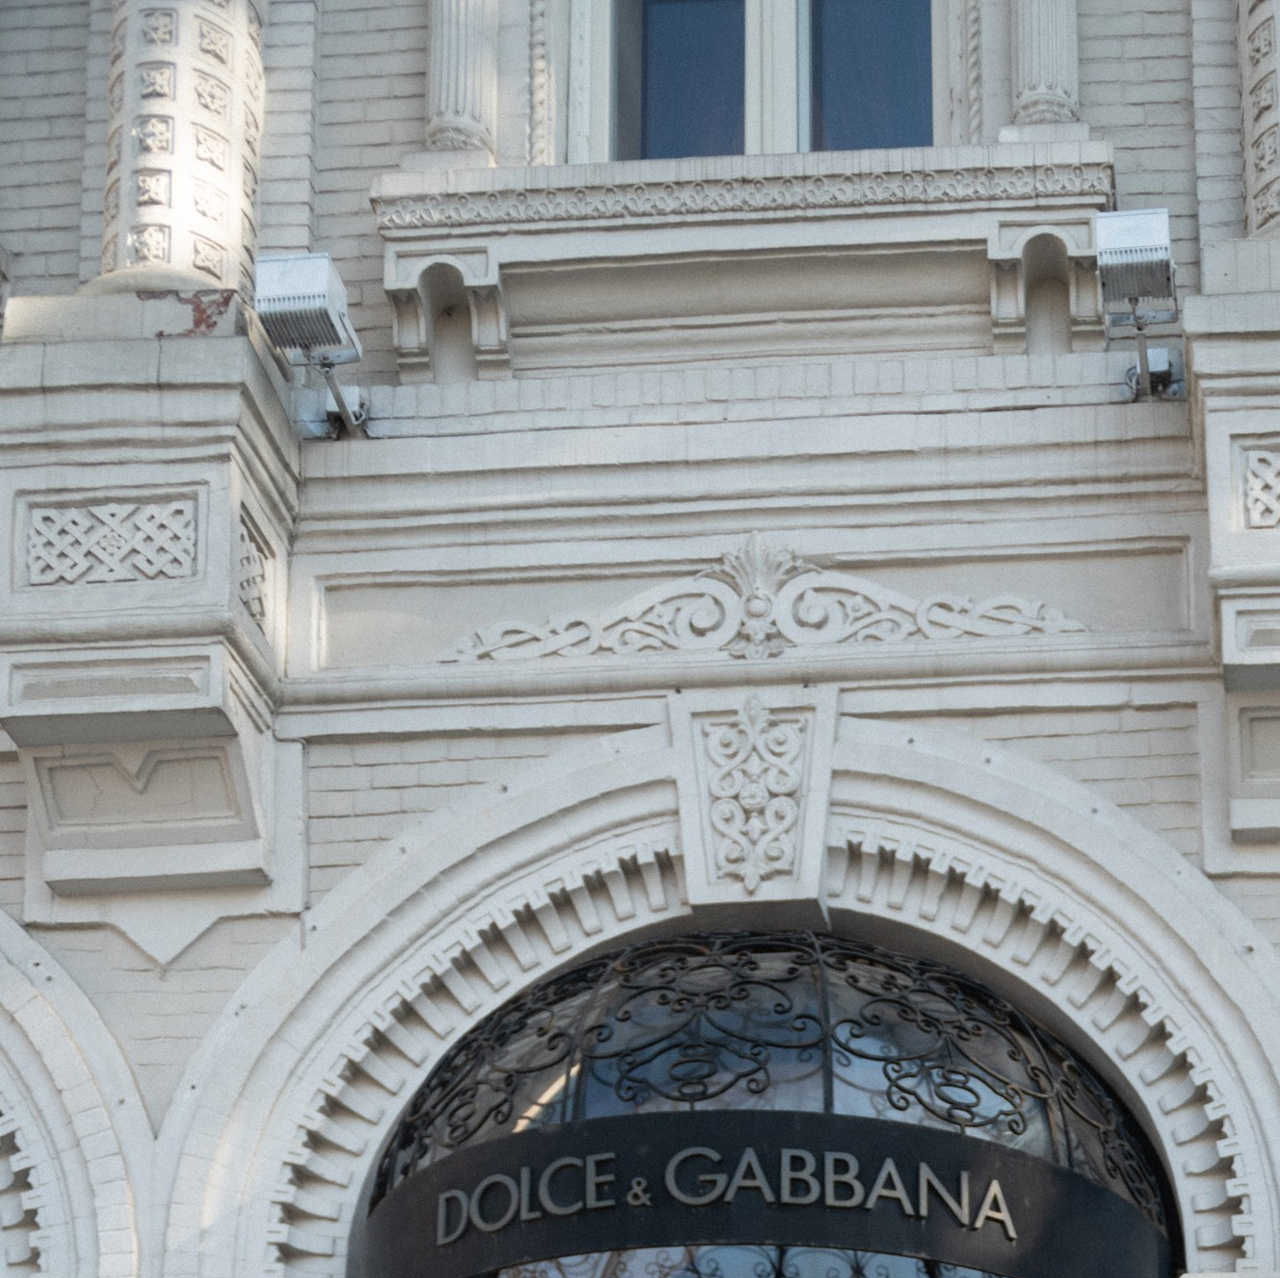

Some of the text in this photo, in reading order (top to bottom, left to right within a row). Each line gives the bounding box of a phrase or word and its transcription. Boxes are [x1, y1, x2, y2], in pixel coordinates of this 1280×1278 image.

[436, 1147, 1018, 1246] DOLCE & GABBANA
